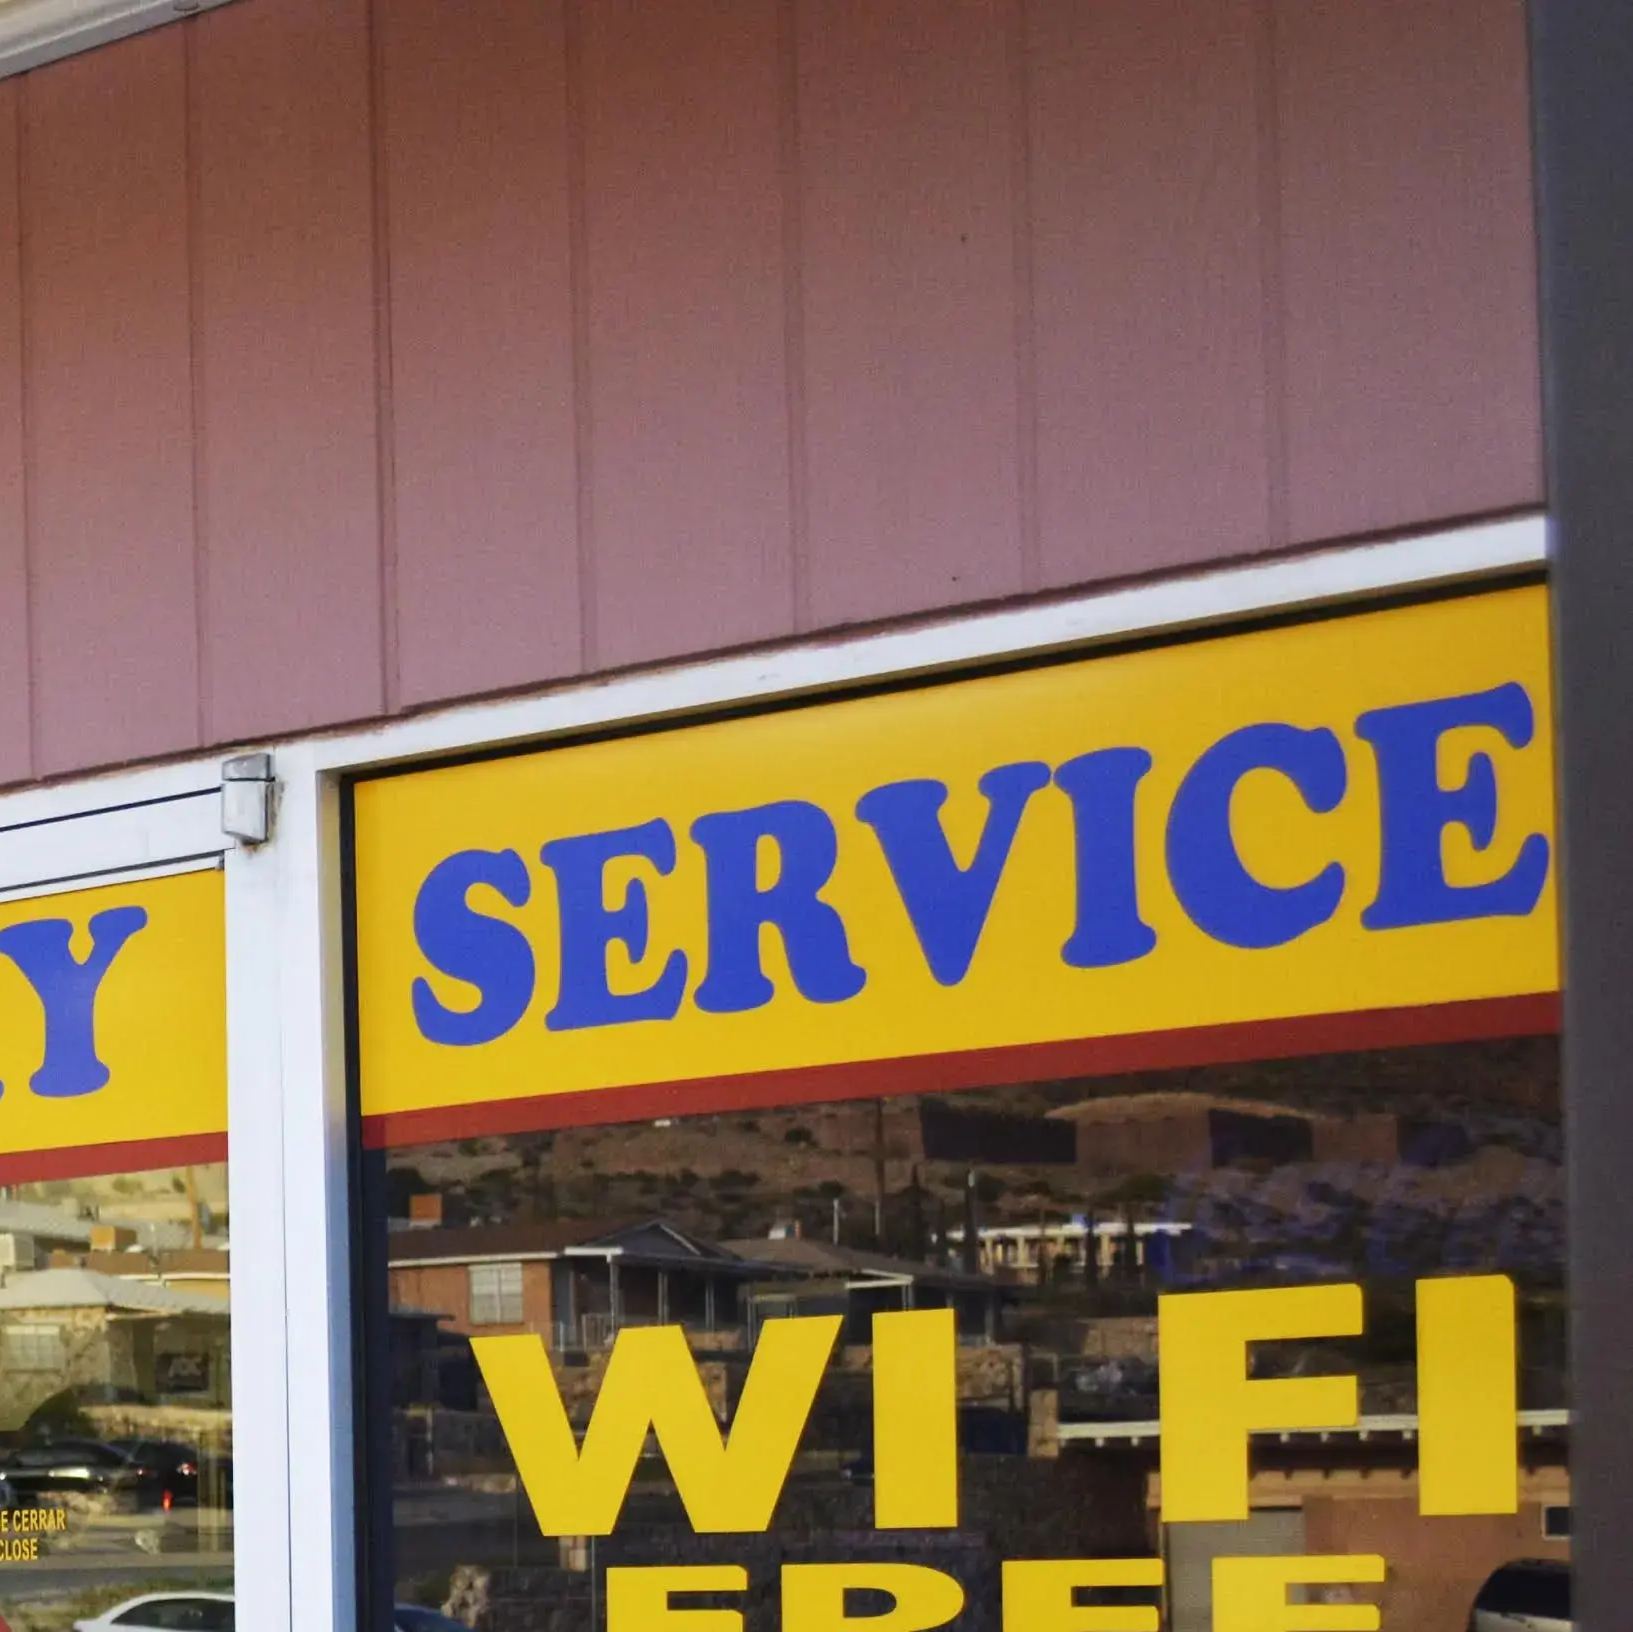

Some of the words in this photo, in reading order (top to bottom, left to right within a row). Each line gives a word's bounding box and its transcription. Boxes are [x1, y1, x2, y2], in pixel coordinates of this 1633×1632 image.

[413, 682, 1549, 1046] SERVICE
[13, 1508, 66, 1531] CERRAR
[469, 1306, 960, 1537] WI
[1159, 1274, 1520, 1523] FI
